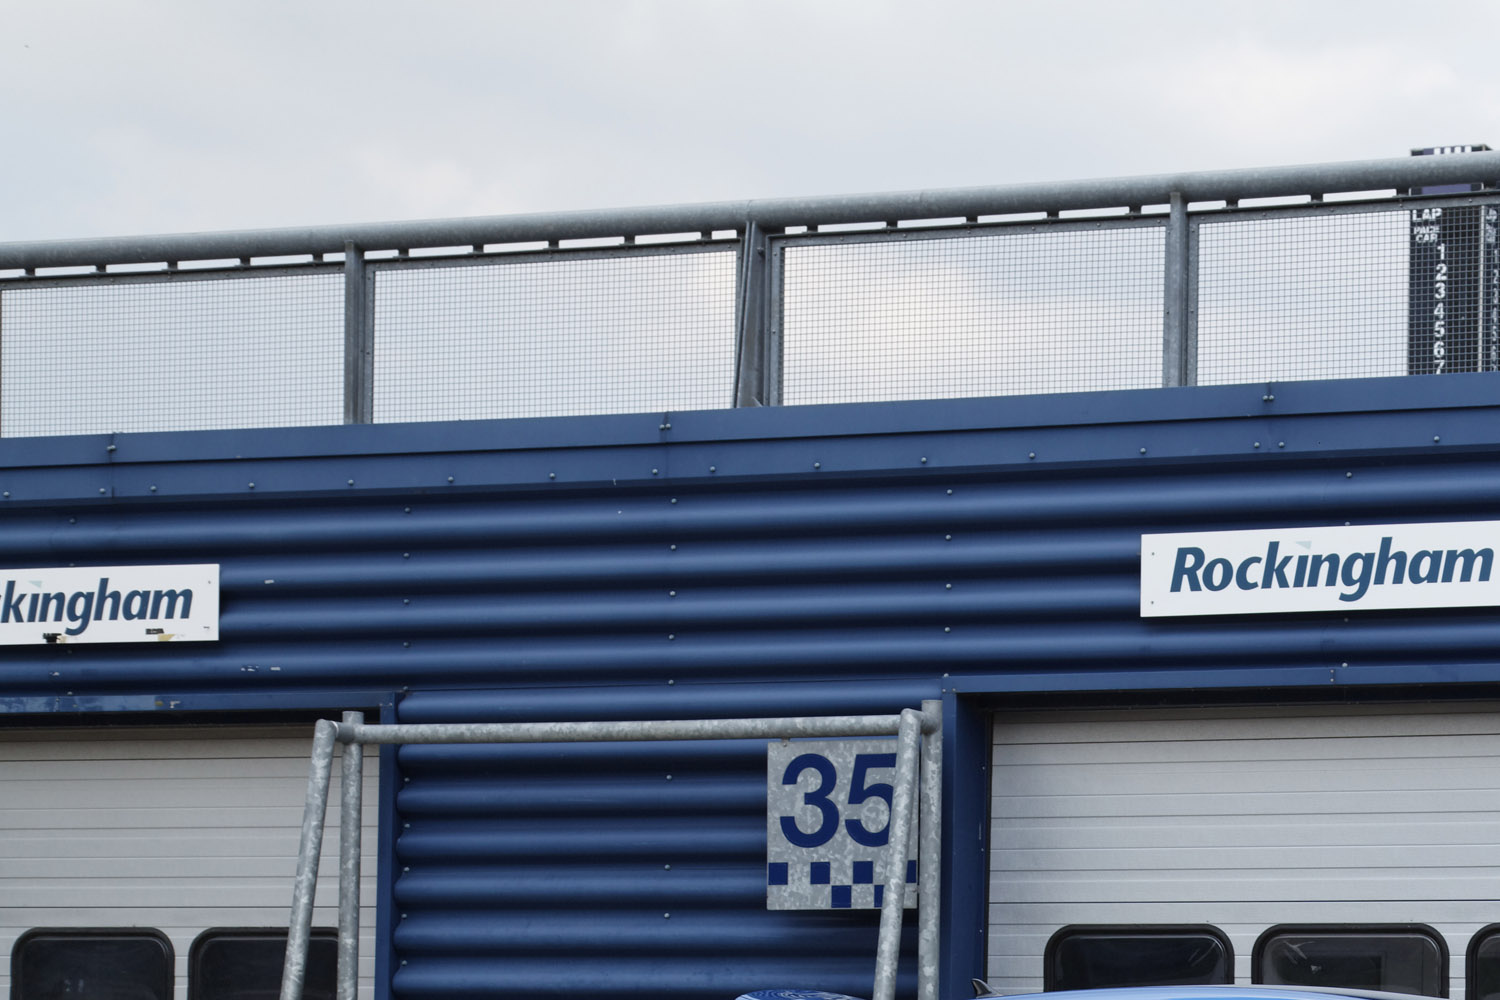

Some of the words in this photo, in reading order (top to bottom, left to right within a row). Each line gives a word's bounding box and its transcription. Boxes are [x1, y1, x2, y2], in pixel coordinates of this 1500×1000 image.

[1412, 208, 1442, 222] LAP
[1415, 233, 1438, 243] CAR
[1437, 243, 1446, 260] 1
[1435, 263, 1447, 281] 2
[1434, 282, 1446, 299] 3
[1433, 302, 1445, 320] 4
[1433, 321, 1445, 338] 5
[1433, 341, 1445, 358] 6
[1433, 360, 1445, 375] 7
[1169, 536, 1495, 602] Rockingham
[0, 577, 193, 636] kingham
[779, 752, 897, 848] 35
